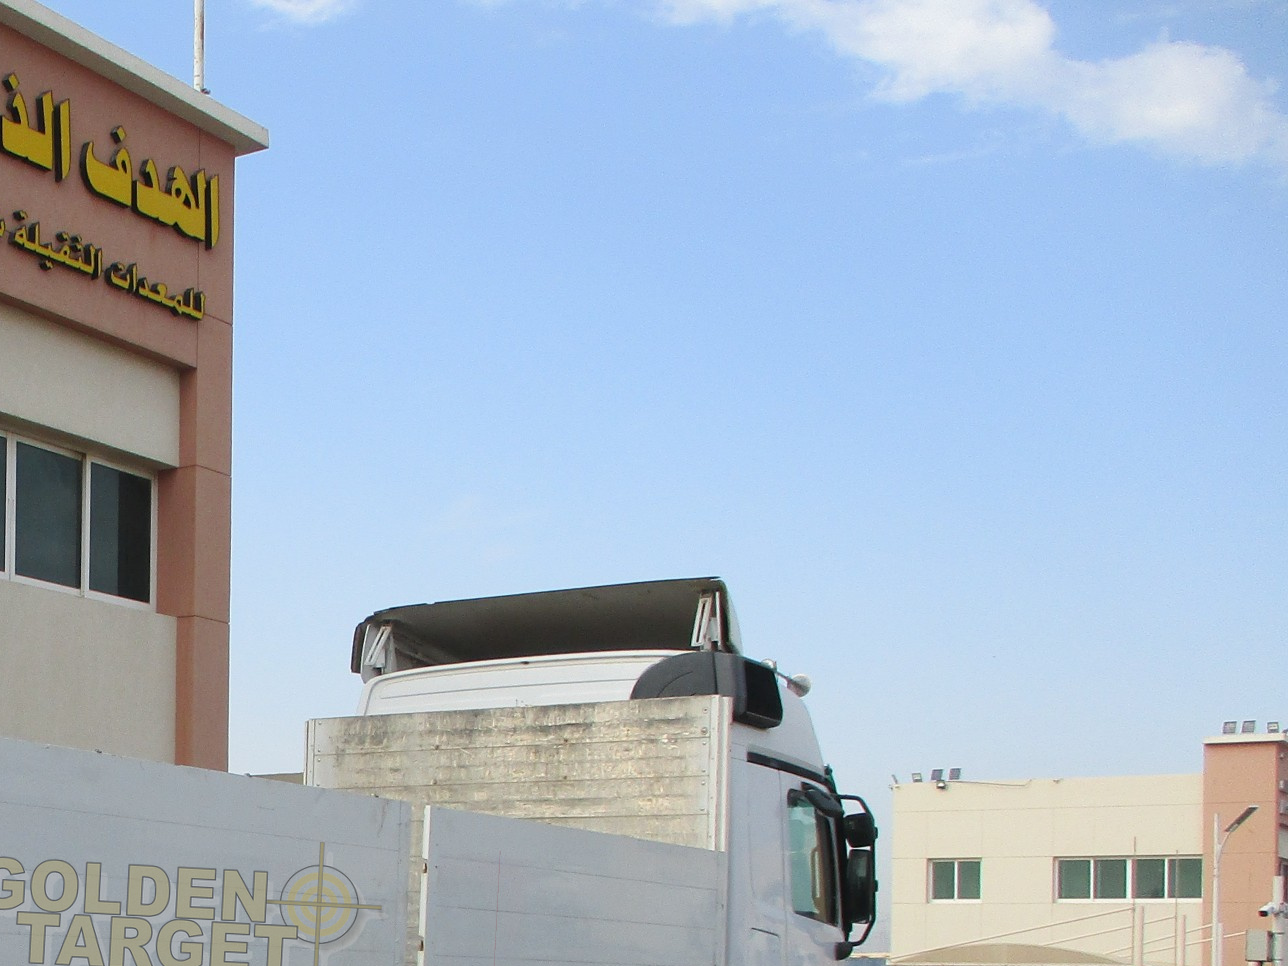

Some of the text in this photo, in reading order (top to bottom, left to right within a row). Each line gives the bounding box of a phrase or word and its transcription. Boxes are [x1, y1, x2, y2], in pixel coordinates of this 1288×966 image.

[80, 125, 219, 251] الهدف
[8, 209, 103, 279] الثقيلة
[105, 262, 206, 321] للمعدات
